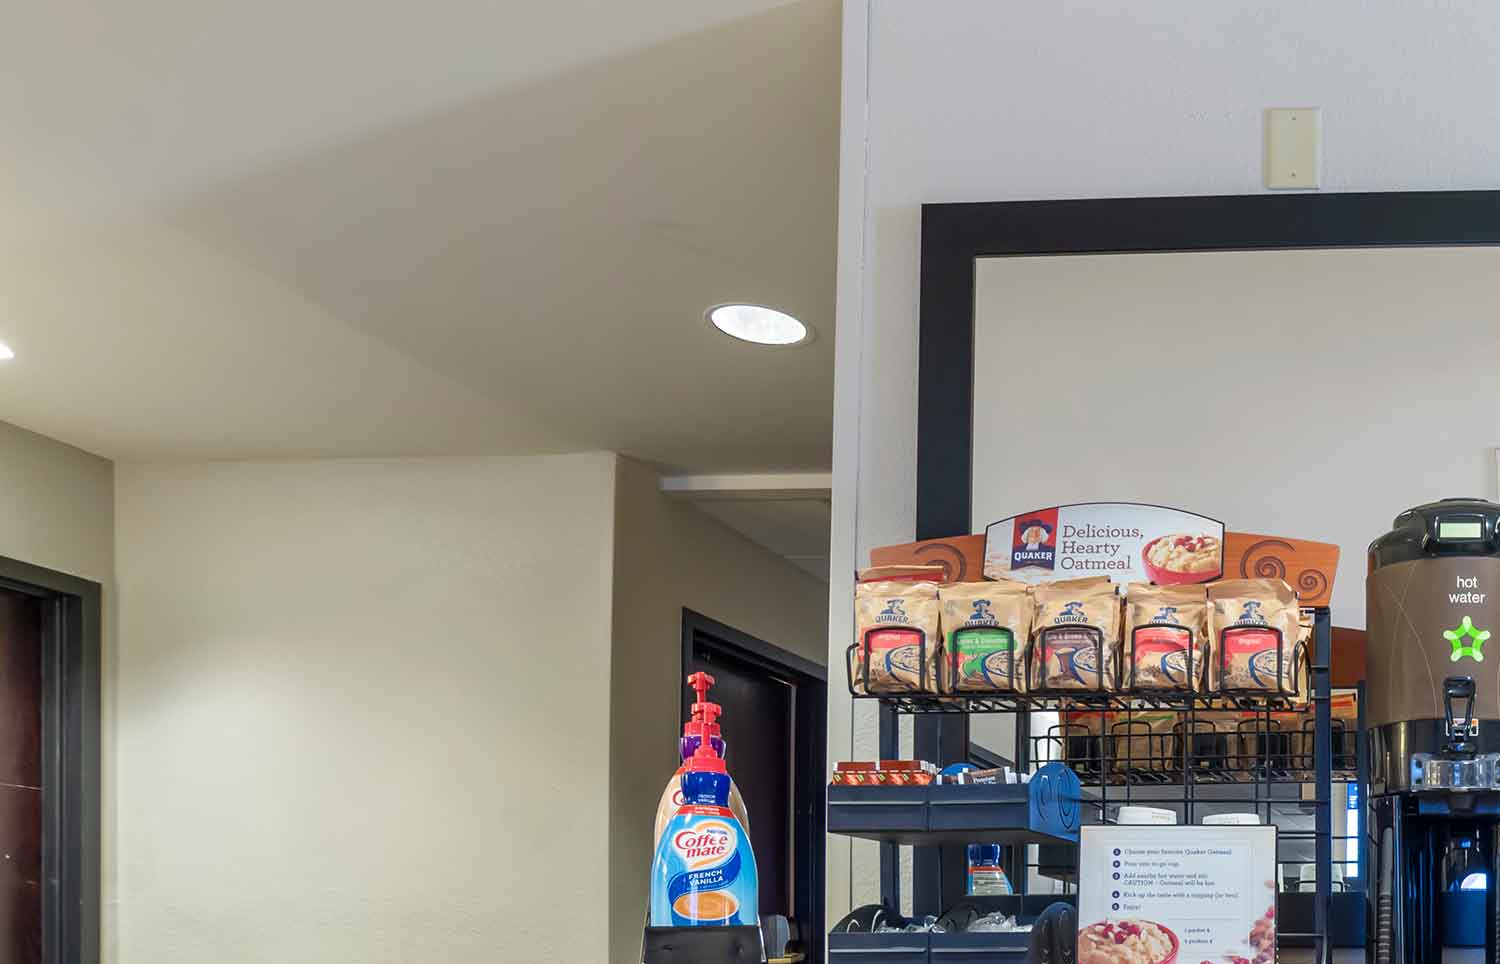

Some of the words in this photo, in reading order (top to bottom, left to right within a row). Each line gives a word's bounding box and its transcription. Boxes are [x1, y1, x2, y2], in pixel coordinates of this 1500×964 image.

[1063, 525, 1144, 539] Delicious,
[1061, 540, 1120, 555] Hearty
[1014, 551, 1053, 562] QUAKER
[1061, 556, 1132, 570] Oatmeal
[1456, 575, 1477, 588] hot
[1448, 592, 1486, 604] water
[875, 615, 909, 624] QUAKER
[1054, 615, 1089, 624] QUAKER
[674, 831, 728, 849] Coffee
[686, 846, 724, 858] mate
[1185, 848, 1206, 856] Quaker
[688, 870, 723, 879] FRENCH
[690, 876, 723, 885] VANILLA
